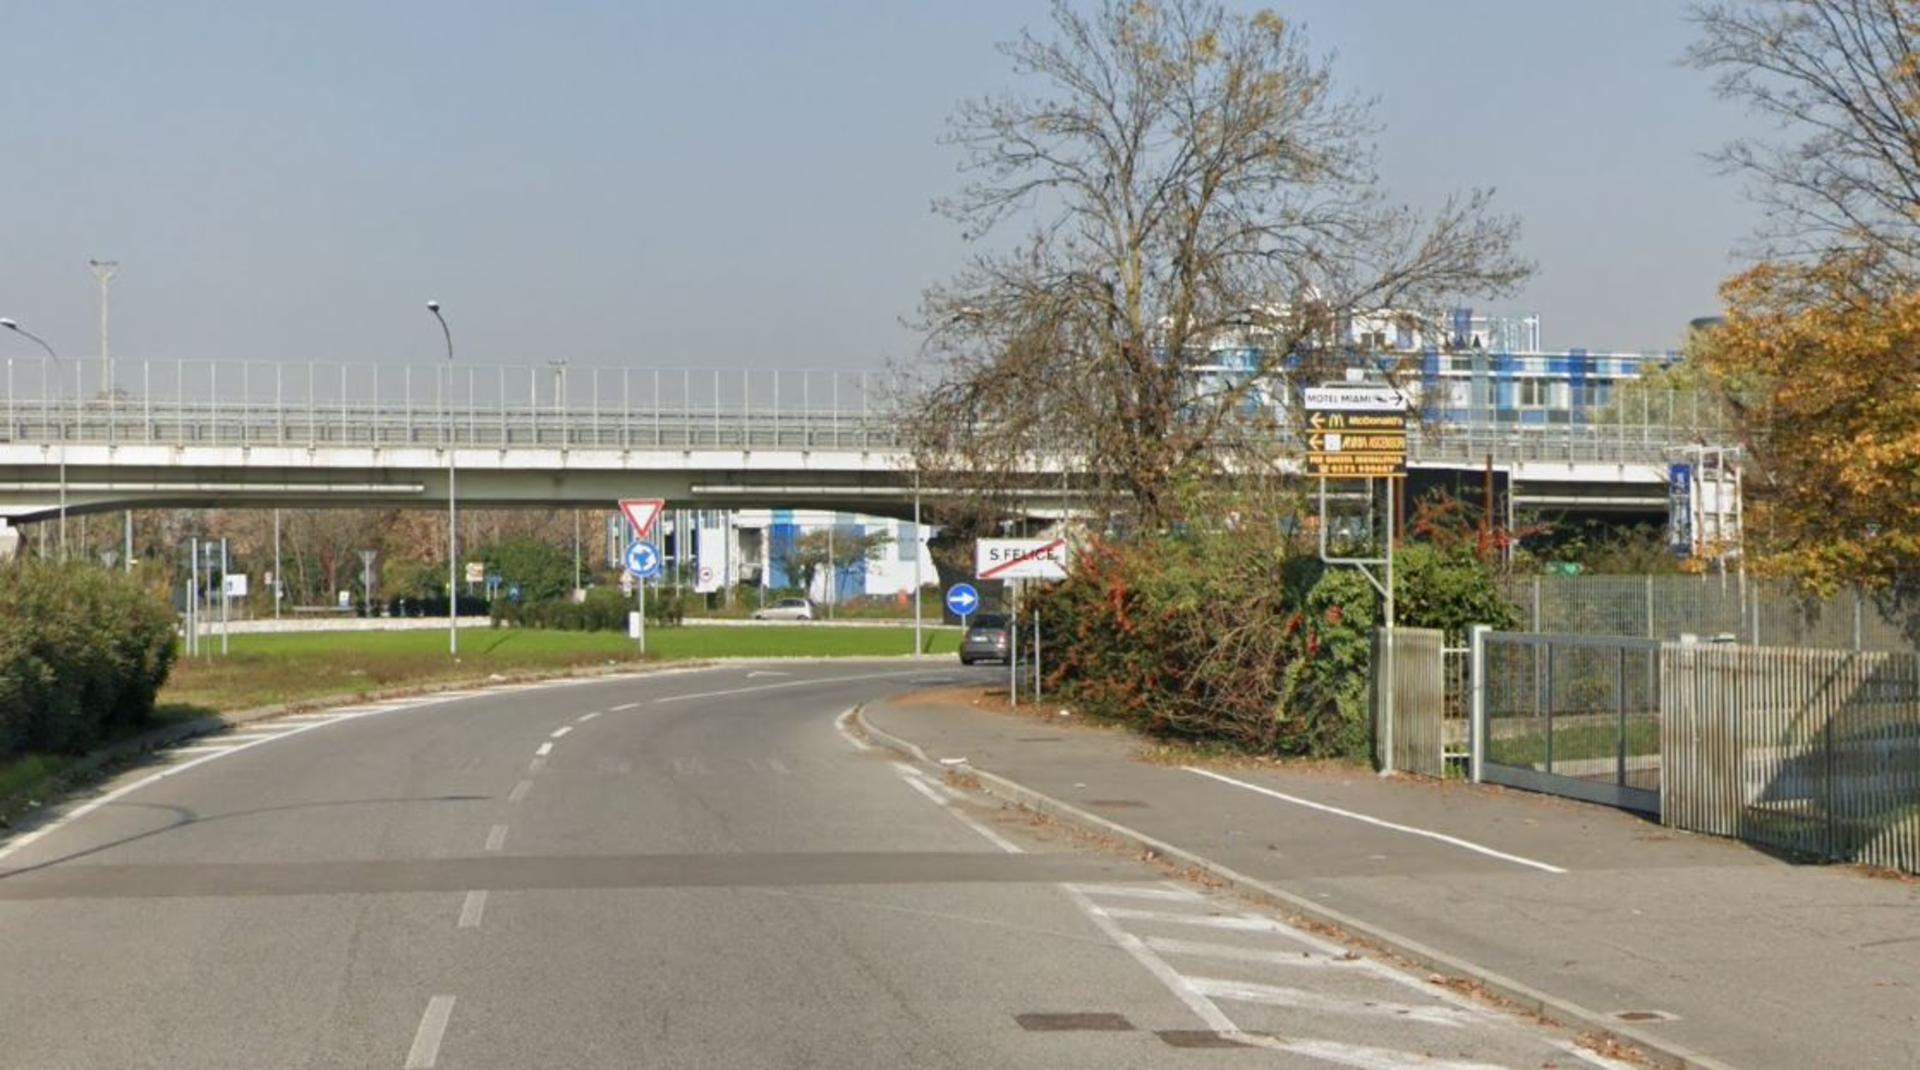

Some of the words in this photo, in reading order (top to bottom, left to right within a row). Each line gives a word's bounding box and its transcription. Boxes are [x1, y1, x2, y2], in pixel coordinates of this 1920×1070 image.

[1307, 394, 1337, 403] MOTEL
[1341, 394, 1371, 403] MIAMI
[1004, 548, 1055, 561] FELICE
